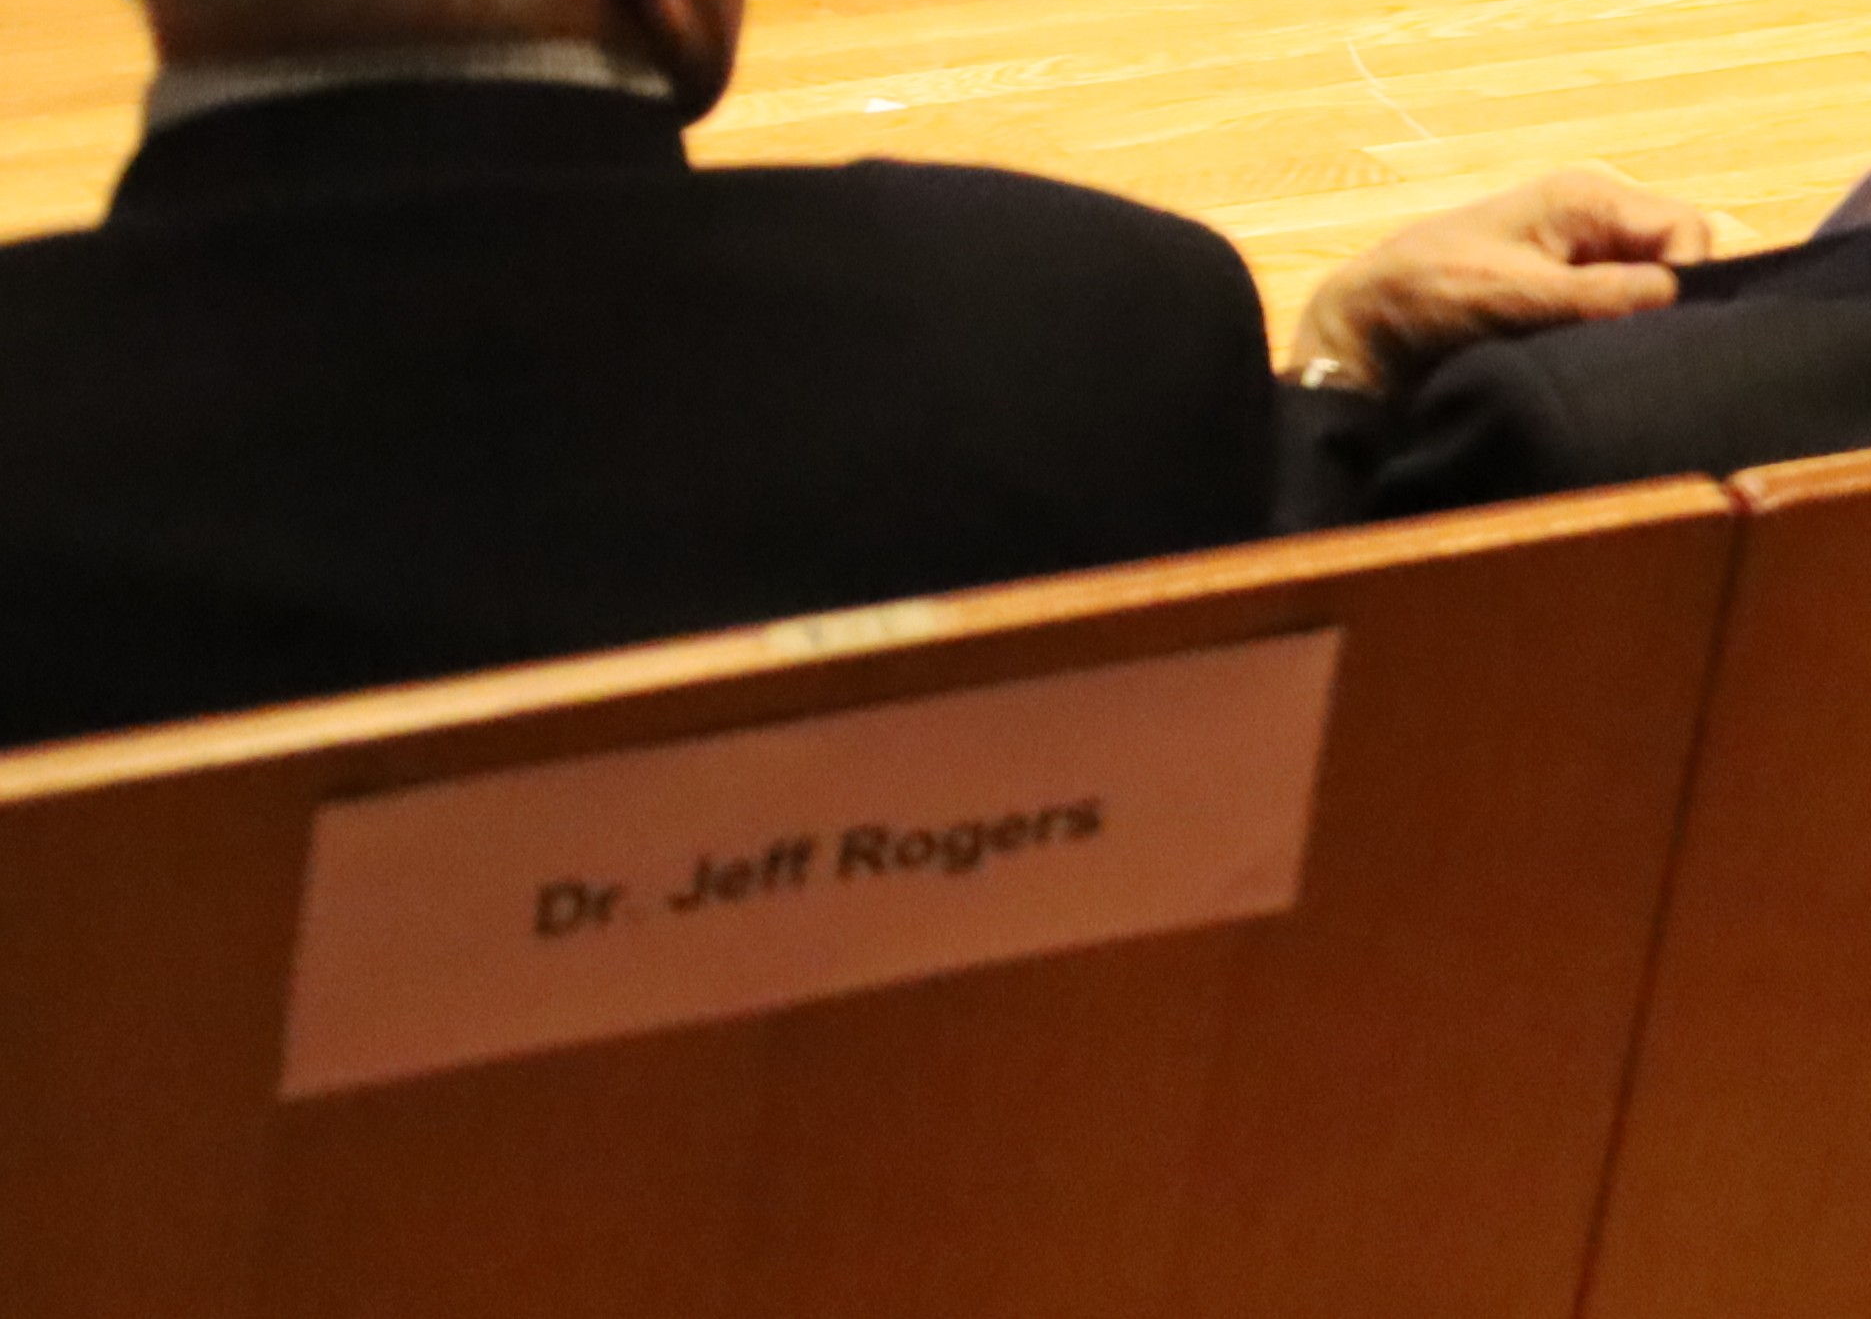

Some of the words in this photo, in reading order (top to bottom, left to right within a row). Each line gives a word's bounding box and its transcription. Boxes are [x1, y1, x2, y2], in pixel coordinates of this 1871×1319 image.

[532, 874, 646, 939] Dr.
[666, 830, 820, 914] Jeff
[835, 797, 1102, 884] Rogers
